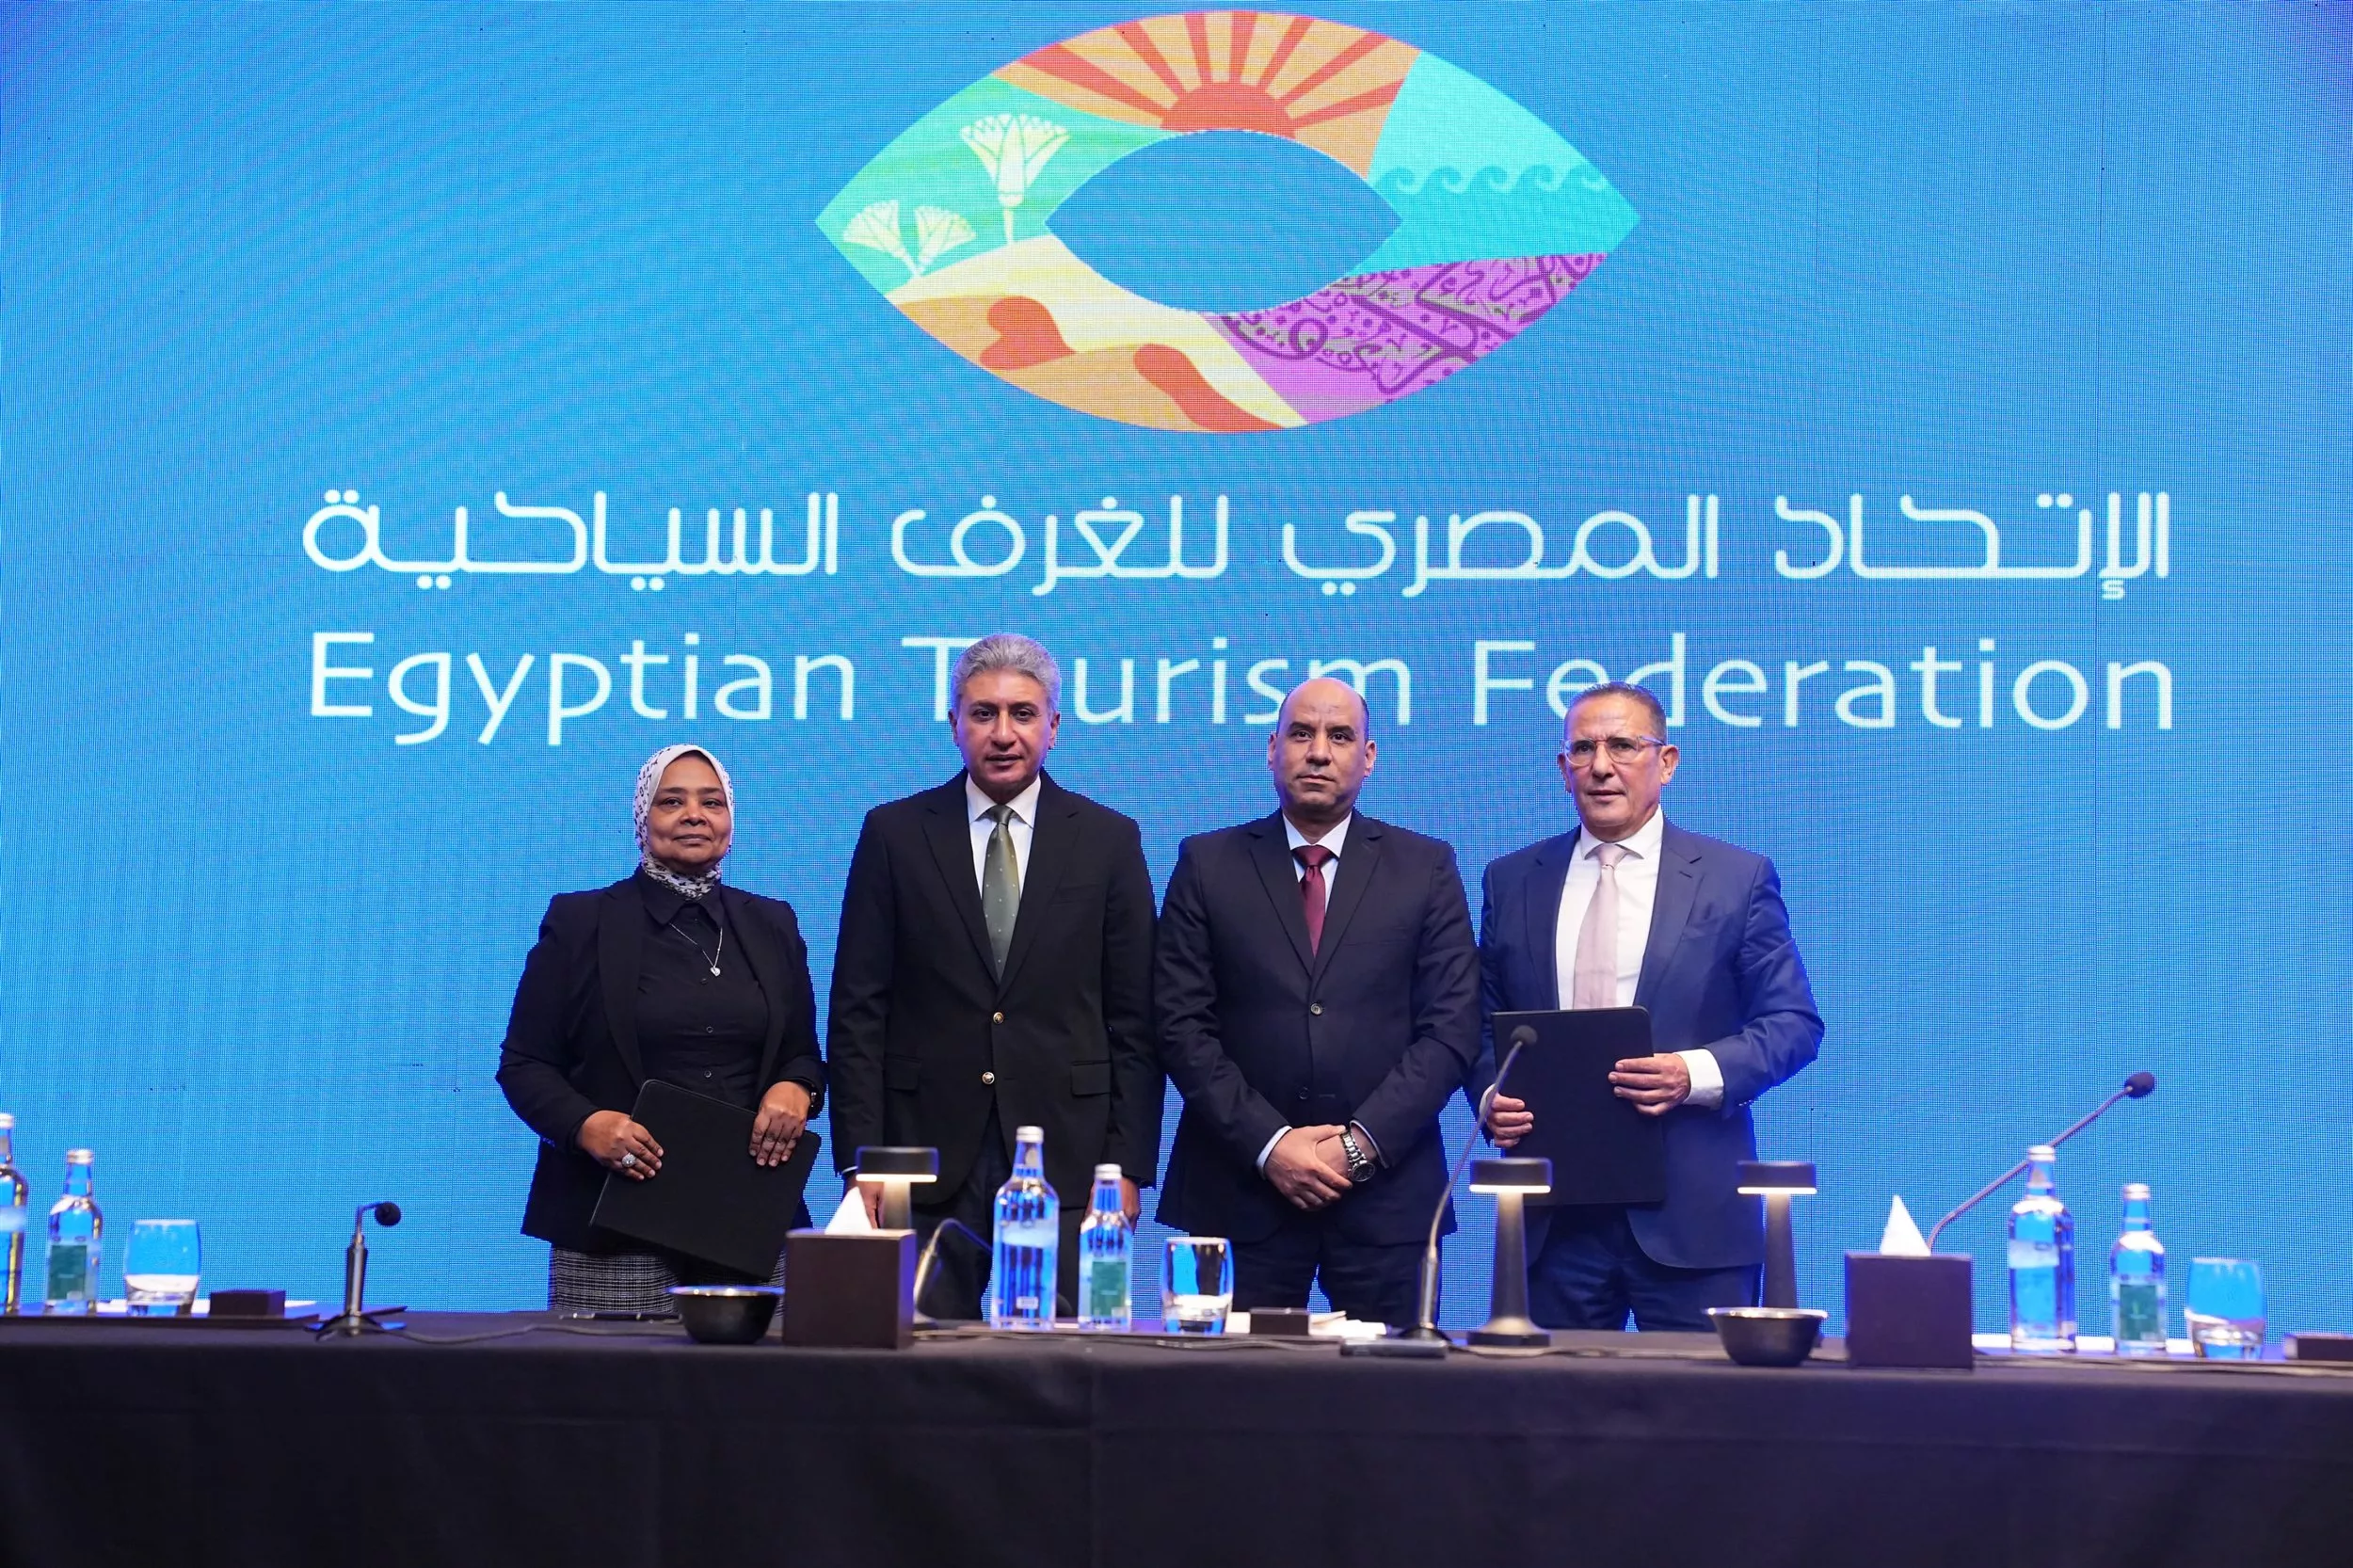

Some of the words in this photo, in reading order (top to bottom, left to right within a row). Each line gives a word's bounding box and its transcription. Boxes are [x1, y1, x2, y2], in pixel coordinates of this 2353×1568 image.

[301, 488, 840, 590] السياحية
[890, 494, 1230, 597] للغرف
[1281, 494, 1720, 597] المصري
[1775, 491, 2171, 600] الإتحاد
[310, 631, 855, 746] Egyptian
[901, 635, 1412, 726] Turism
[1472, 632, 2174, 730] Federation
